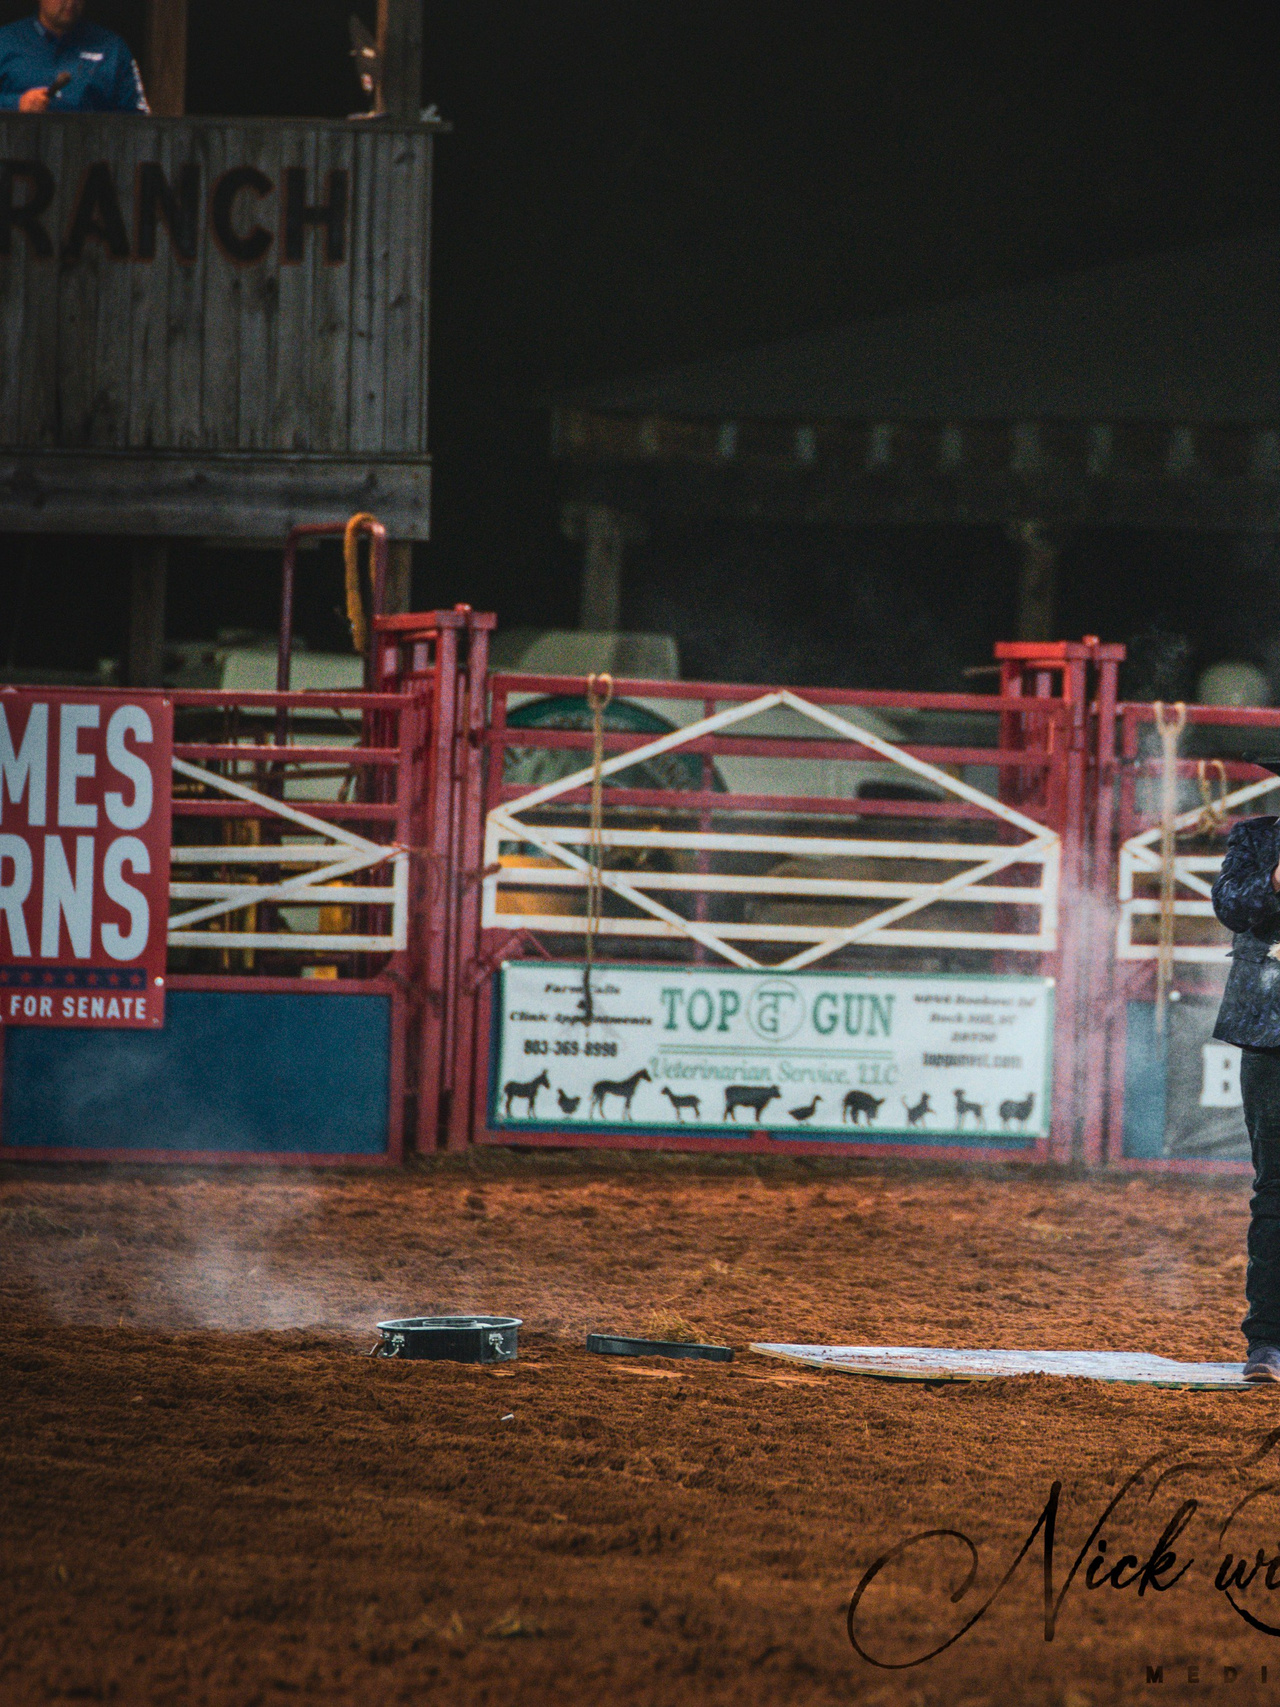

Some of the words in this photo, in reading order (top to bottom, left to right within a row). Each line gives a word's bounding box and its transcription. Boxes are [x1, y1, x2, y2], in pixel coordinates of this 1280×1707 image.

[0, 159, 350, 267] RANCH
[10, 995, 53, 1018] FOR
[62, 996, 147, 1020] SENATE
[661, 987, 741, 1032] TOP
[812, 992, 896, 1036] GUN
[650, 1056, 772, 1082] Veterinarian
